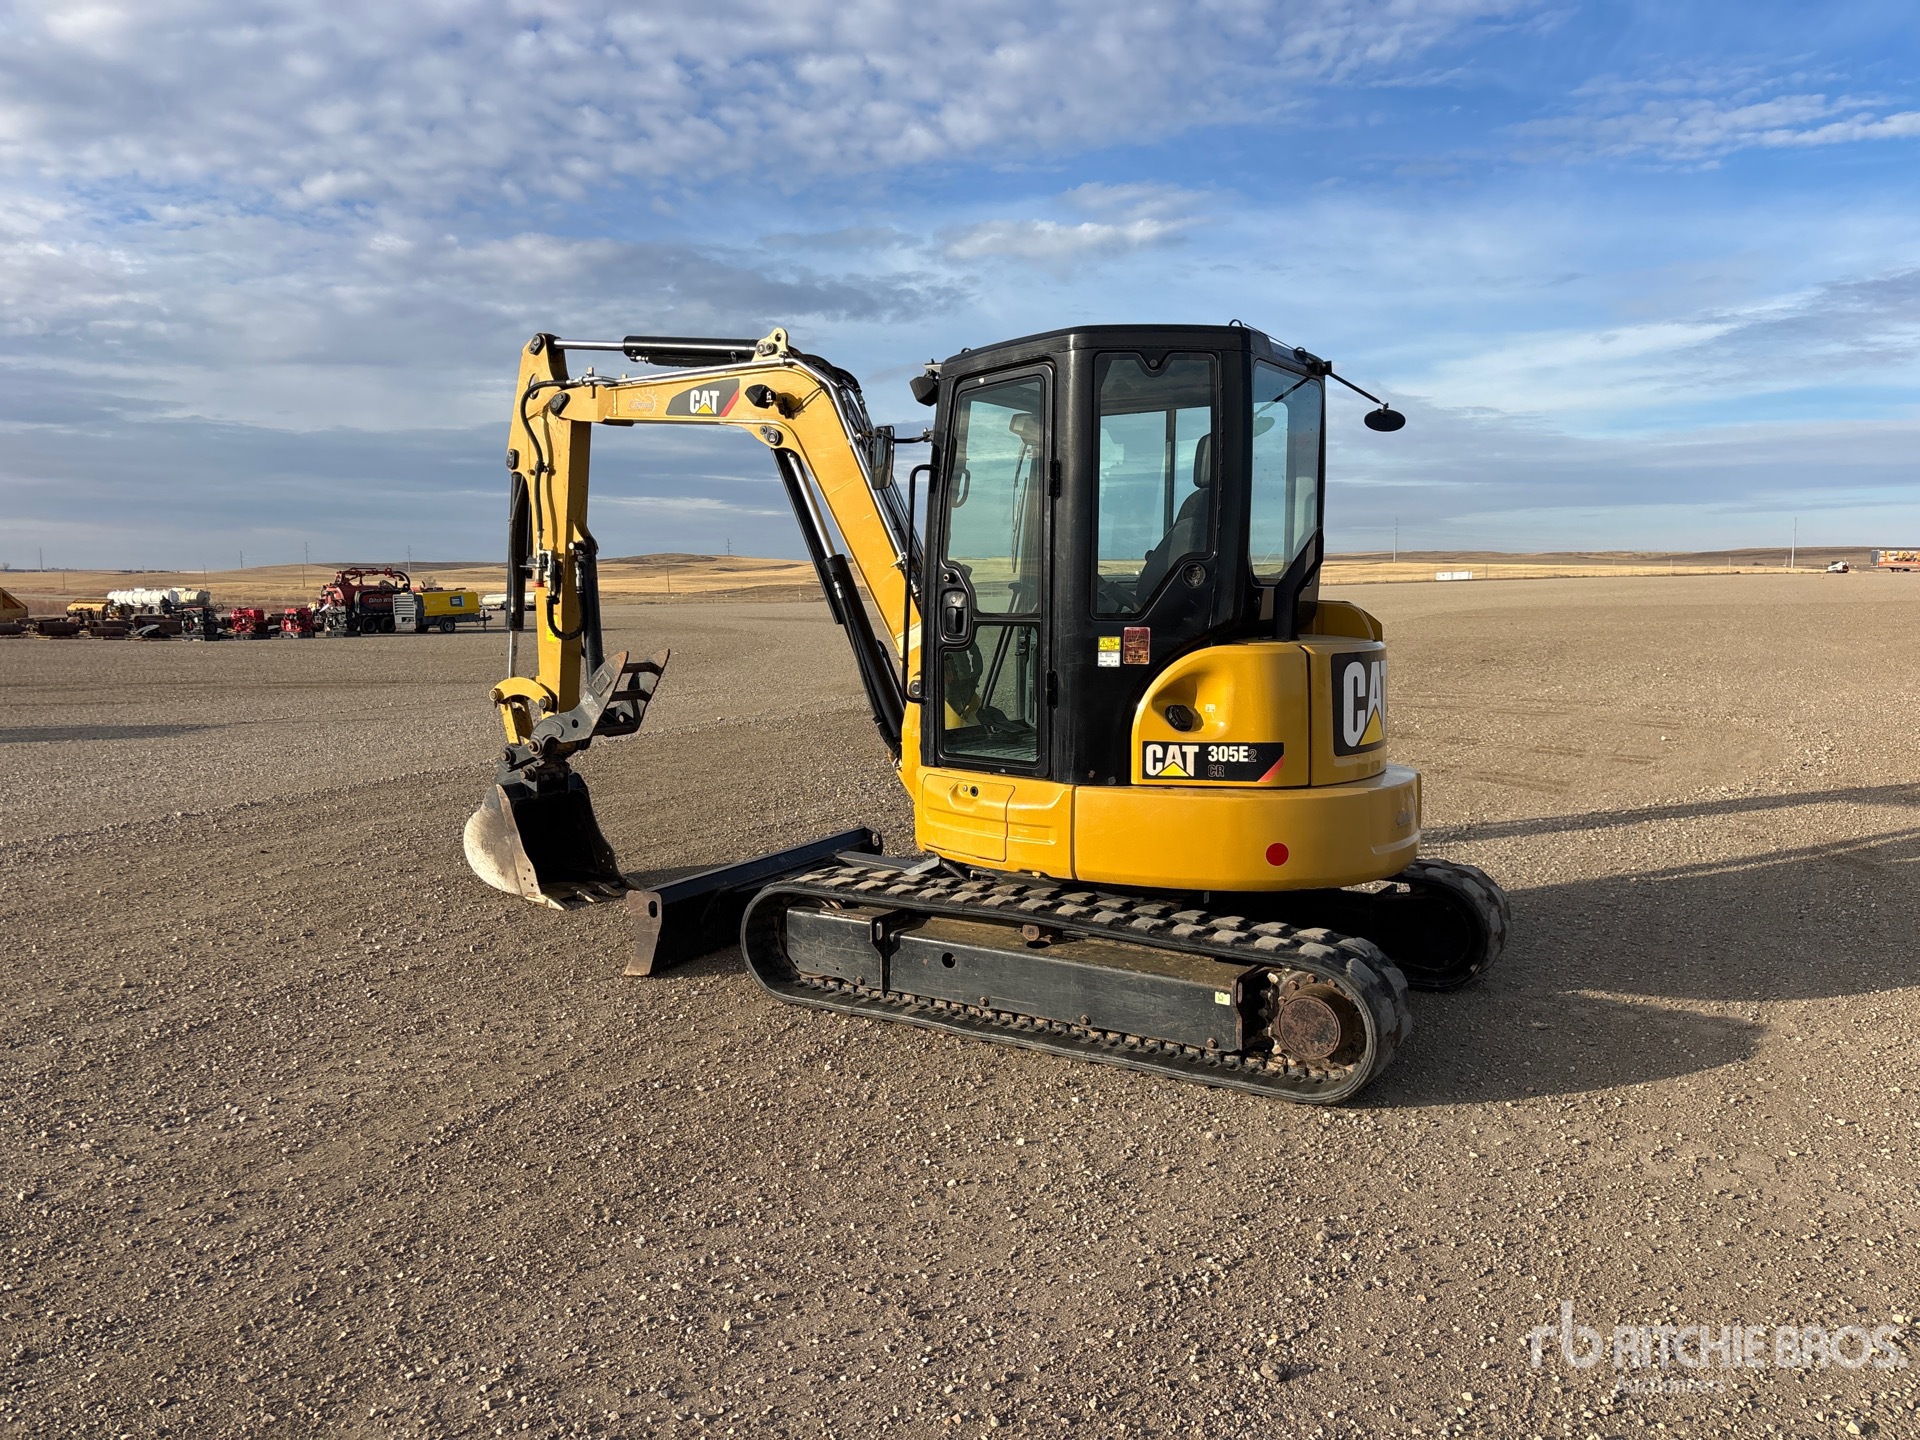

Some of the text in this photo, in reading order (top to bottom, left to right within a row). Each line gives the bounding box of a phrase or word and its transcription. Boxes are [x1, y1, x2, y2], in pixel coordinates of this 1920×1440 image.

[689, 389, 720, 415] CAT
[1145, 743, 1258, 777] CAT 305E2
[1207, 764, 1226, 778] CR
